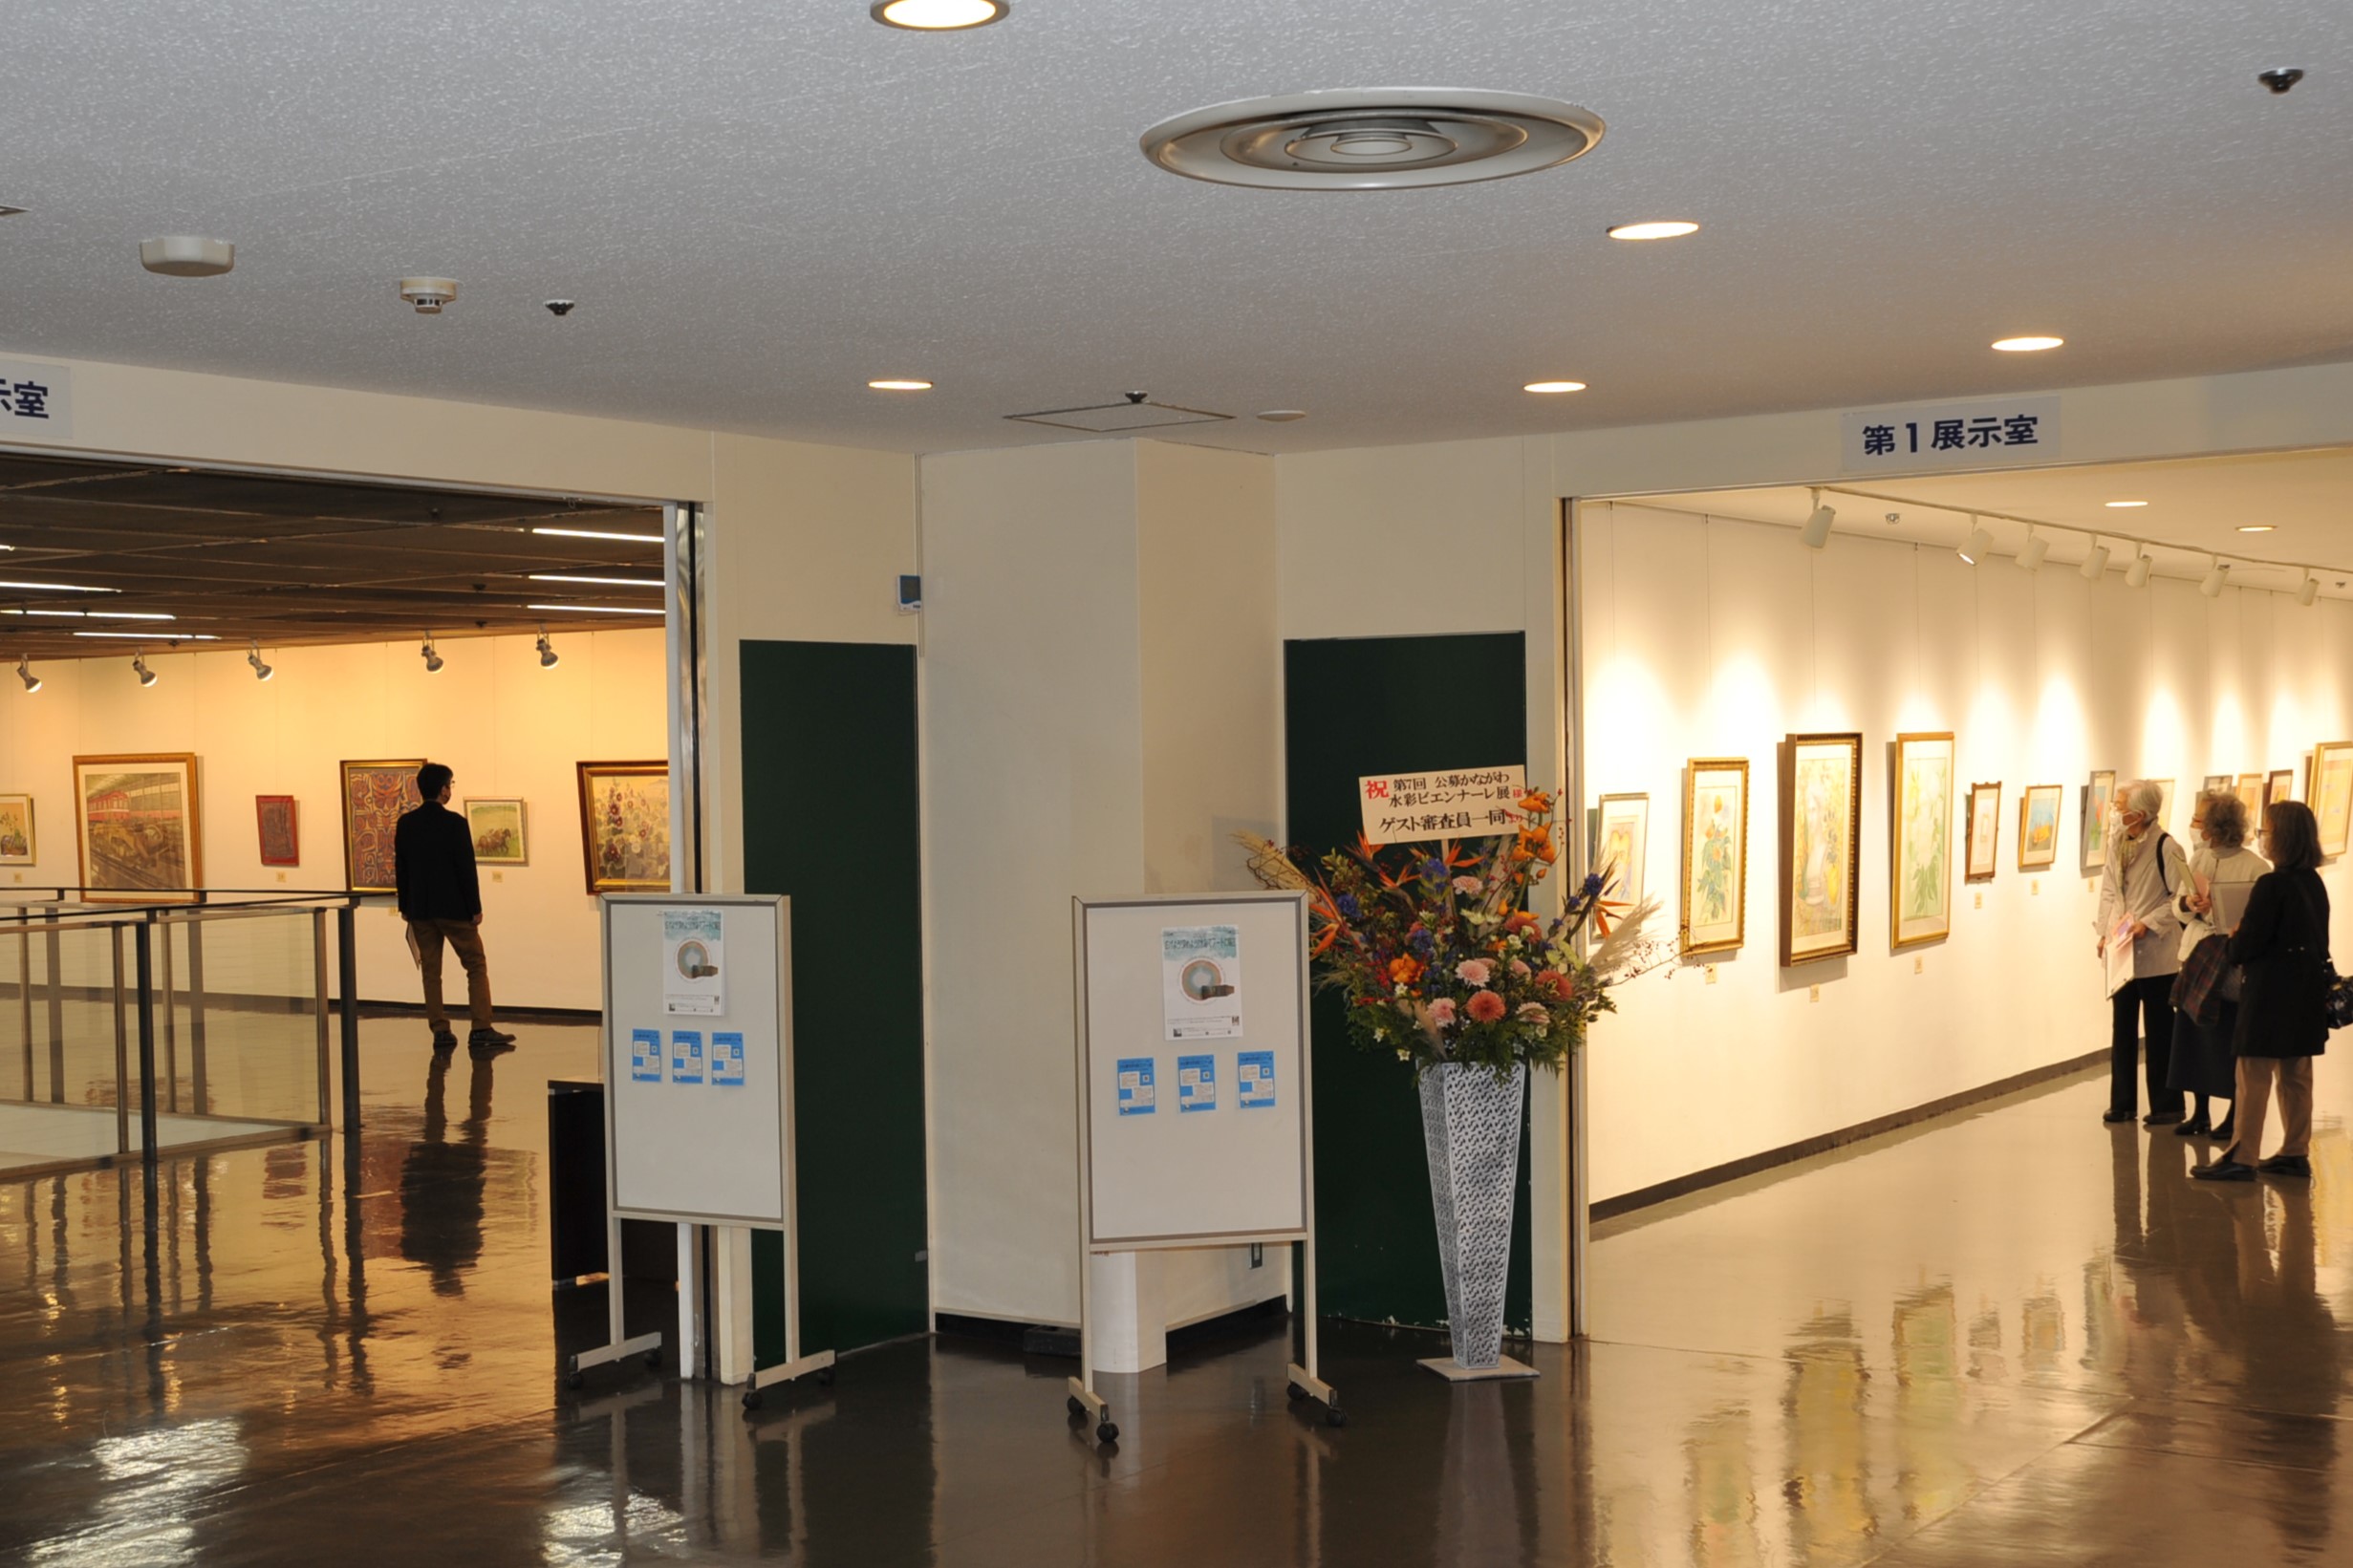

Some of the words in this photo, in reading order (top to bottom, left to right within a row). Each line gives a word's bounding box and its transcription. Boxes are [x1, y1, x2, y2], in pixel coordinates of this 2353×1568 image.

[1862, 414, 2039, 456] 第1展示室
[1365, 780, 1390, 800] 祝
[1393, 777, 1427, 792] 第7回
[1435, 770, 1510, 789] 公募かながわ
[1389, 785, 1510, 808] 水彩ビエンナーレ展
[1379, 808, 1505, 834] ゲスト審査員一同
